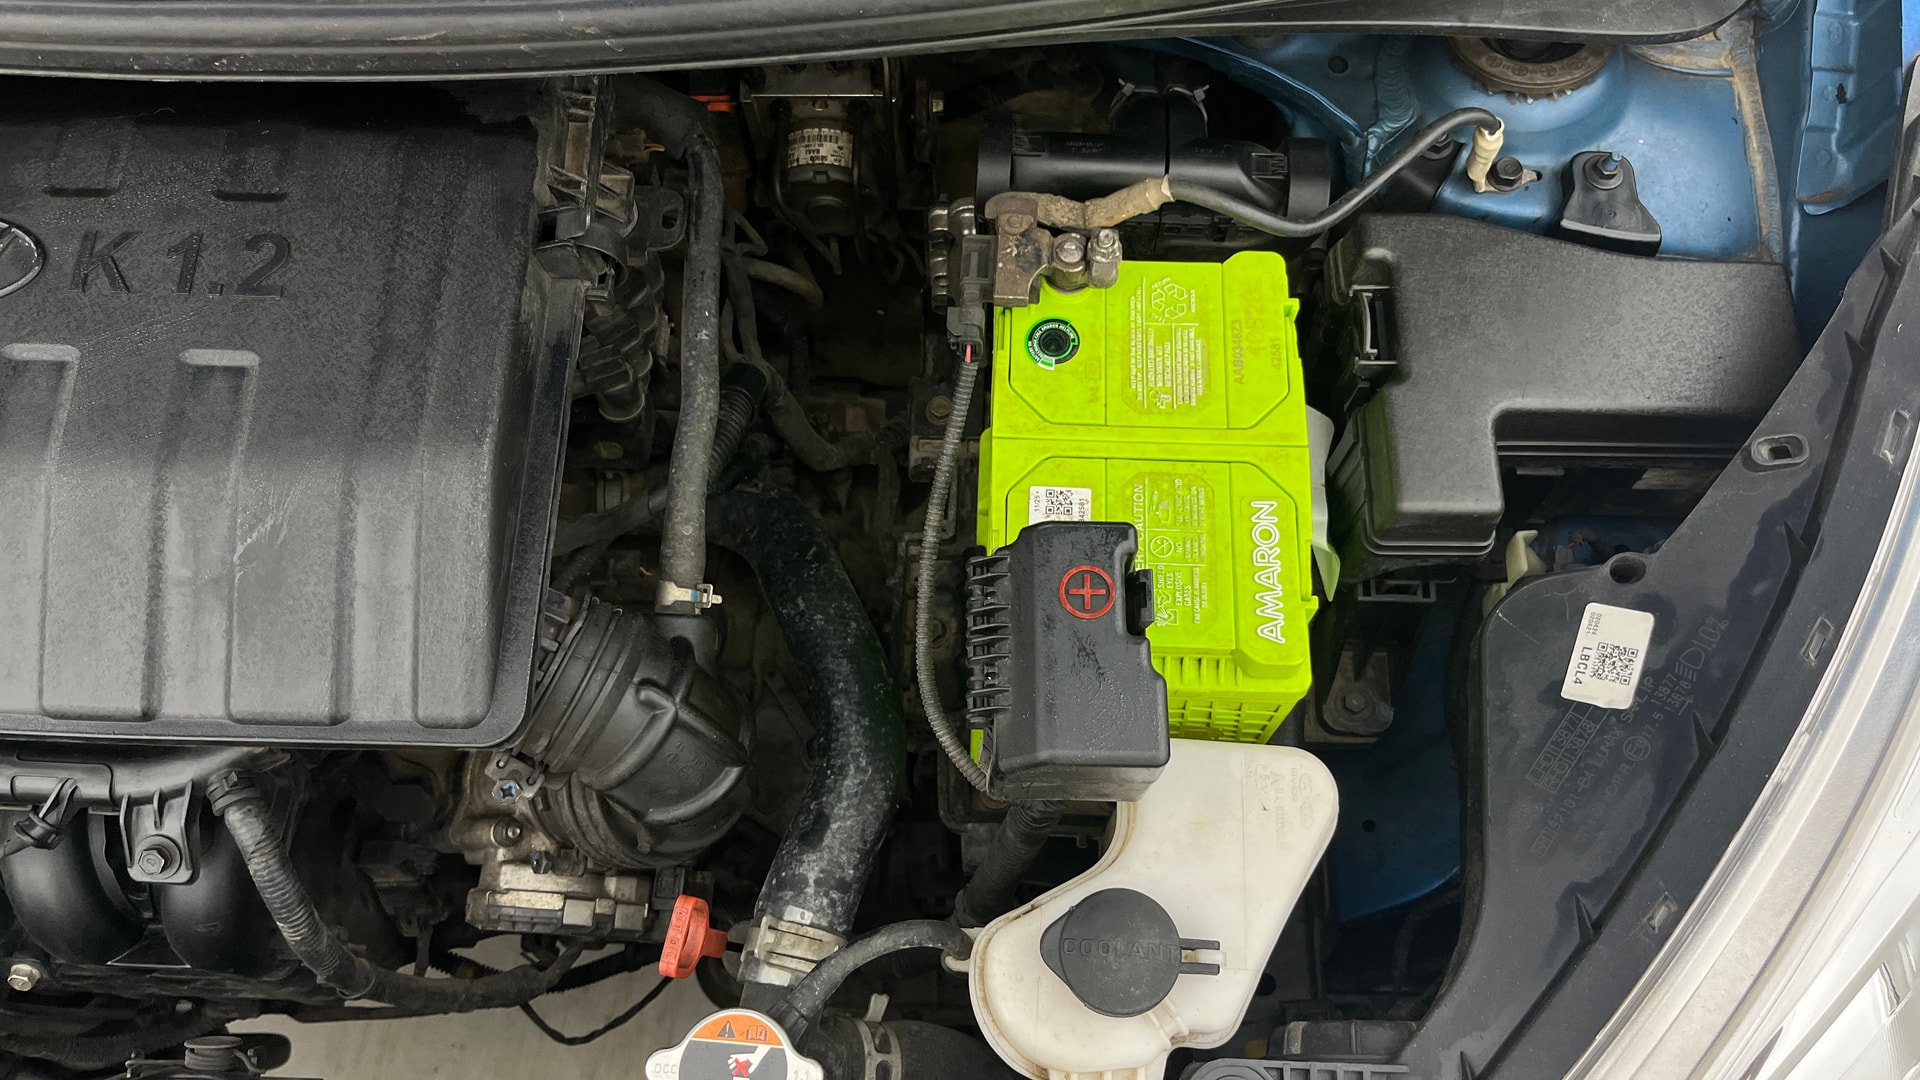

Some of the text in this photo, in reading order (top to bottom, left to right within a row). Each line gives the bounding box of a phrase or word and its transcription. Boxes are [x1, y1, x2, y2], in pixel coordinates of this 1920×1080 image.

[68, 229, 292, 299] K 1.2
[1176, 542, 1183, 553] NO
[1175, 571, 1183, 606] EXPLOSIVE
[1251, 501, 1286, 643] AMARON
[1573, 646, 1592, 685] LBCL4
[1649, 671, 1679, 707] 13877
[1547, 712, 1582, 753] 13877
[1591, 727, 1625, 769] LUMAX
[1063, 937, 1180, 962] COOLANT
